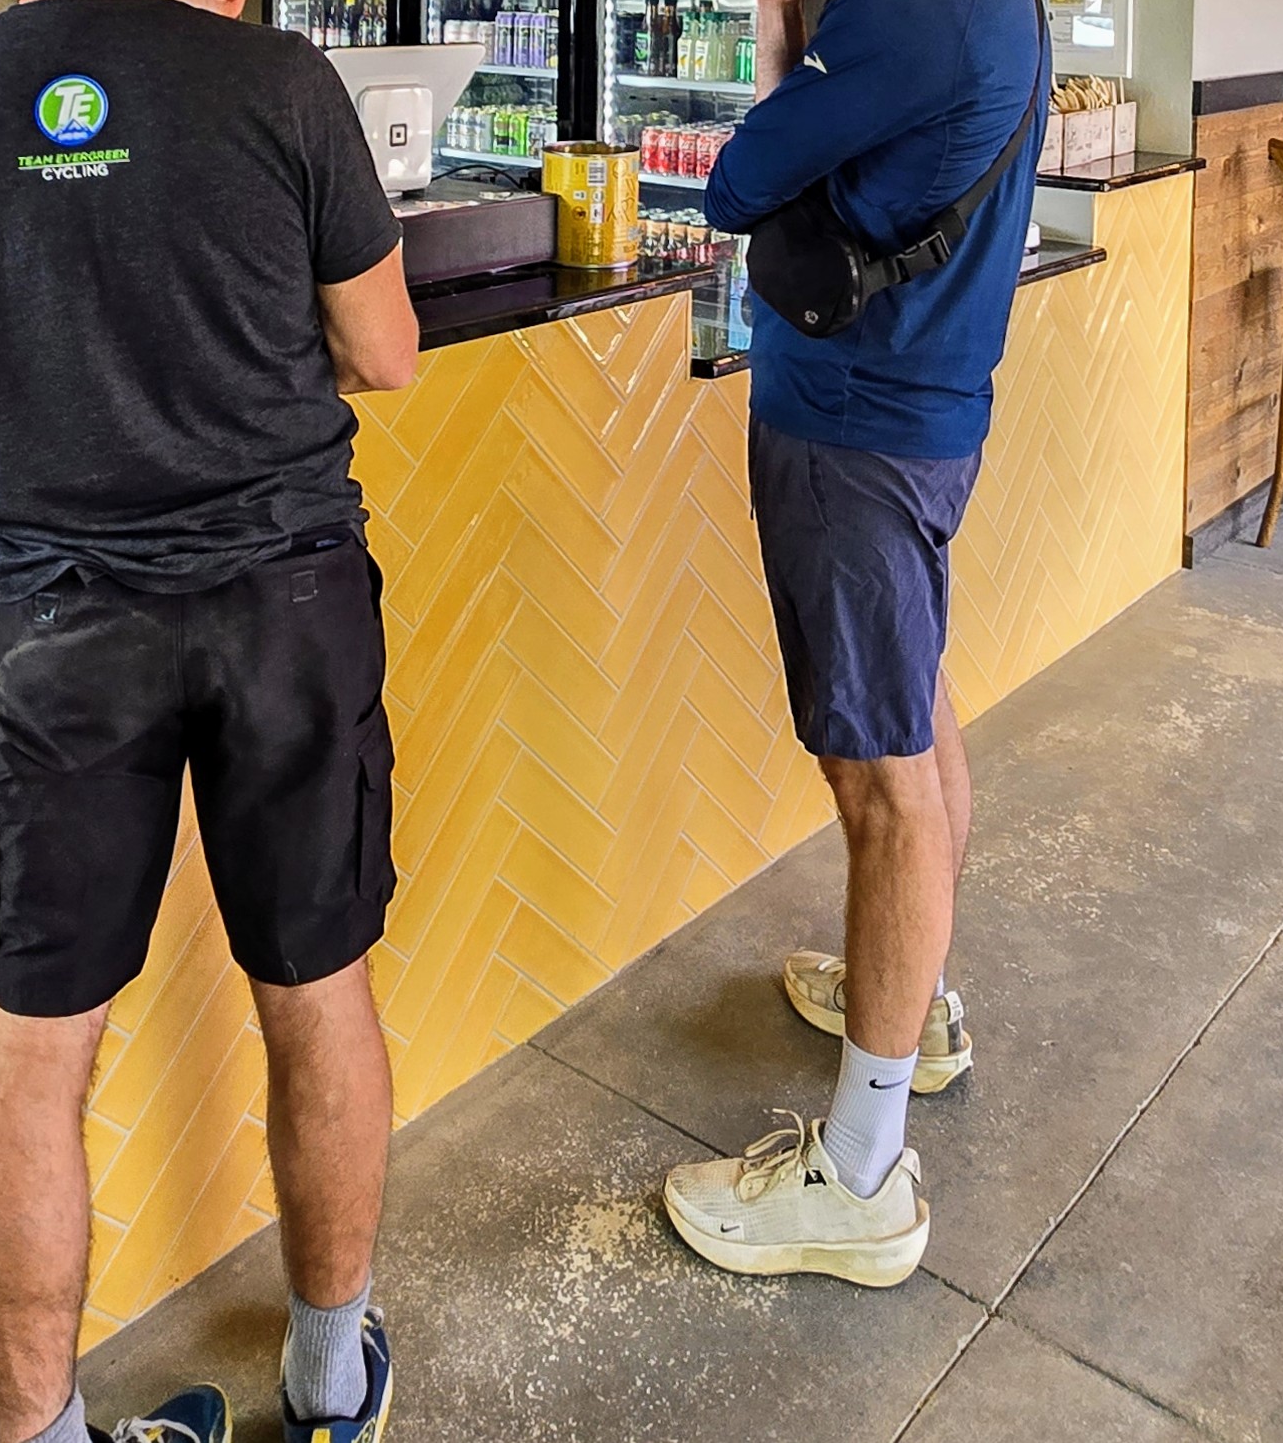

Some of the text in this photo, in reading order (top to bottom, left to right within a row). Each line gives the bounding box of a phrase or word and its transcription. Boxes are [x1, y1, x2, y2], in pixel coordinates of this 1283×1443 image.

[55, 85, 95, 127] TE
[55, 149, 130, 164] EVERGREEN
[41, 163, 109, 181] CYCLING
